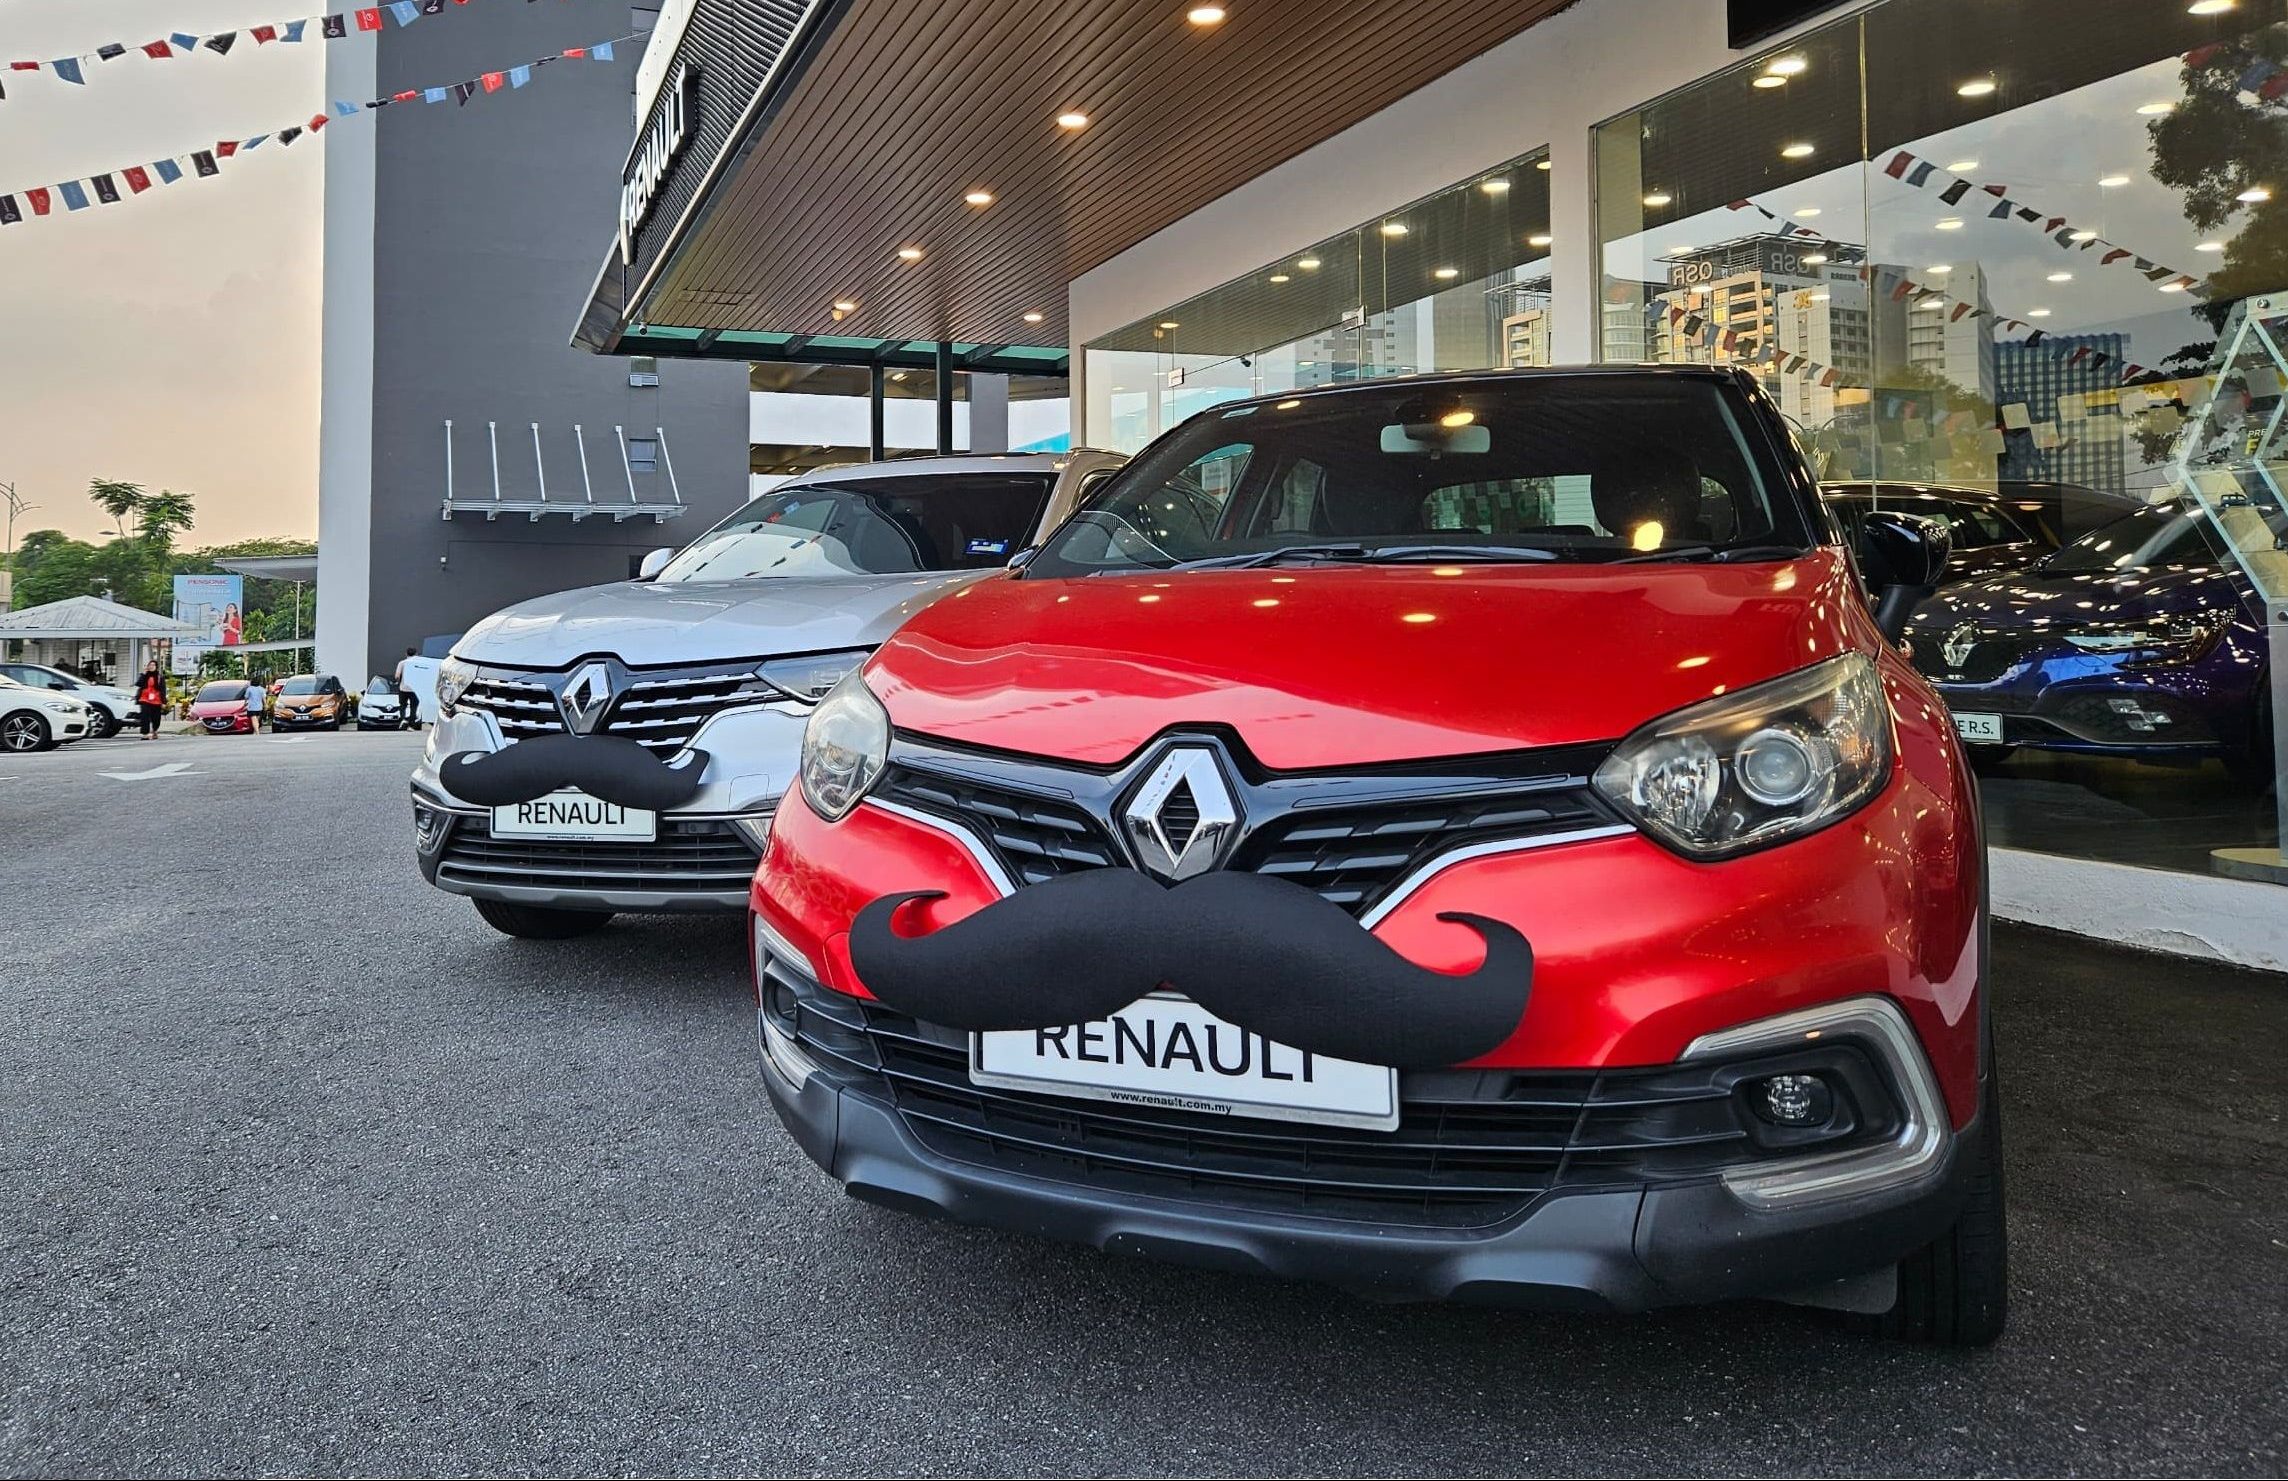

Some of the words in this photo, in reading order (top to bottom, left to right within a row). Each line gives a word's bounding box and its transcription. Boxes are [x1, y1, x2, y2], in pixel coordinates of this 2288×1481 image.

[628, 62, 686, 236] RENAULT
[1969, 720, 1994, 735] R.S.
[1110, 1091, 1232, 1116] www.renault.com.my
